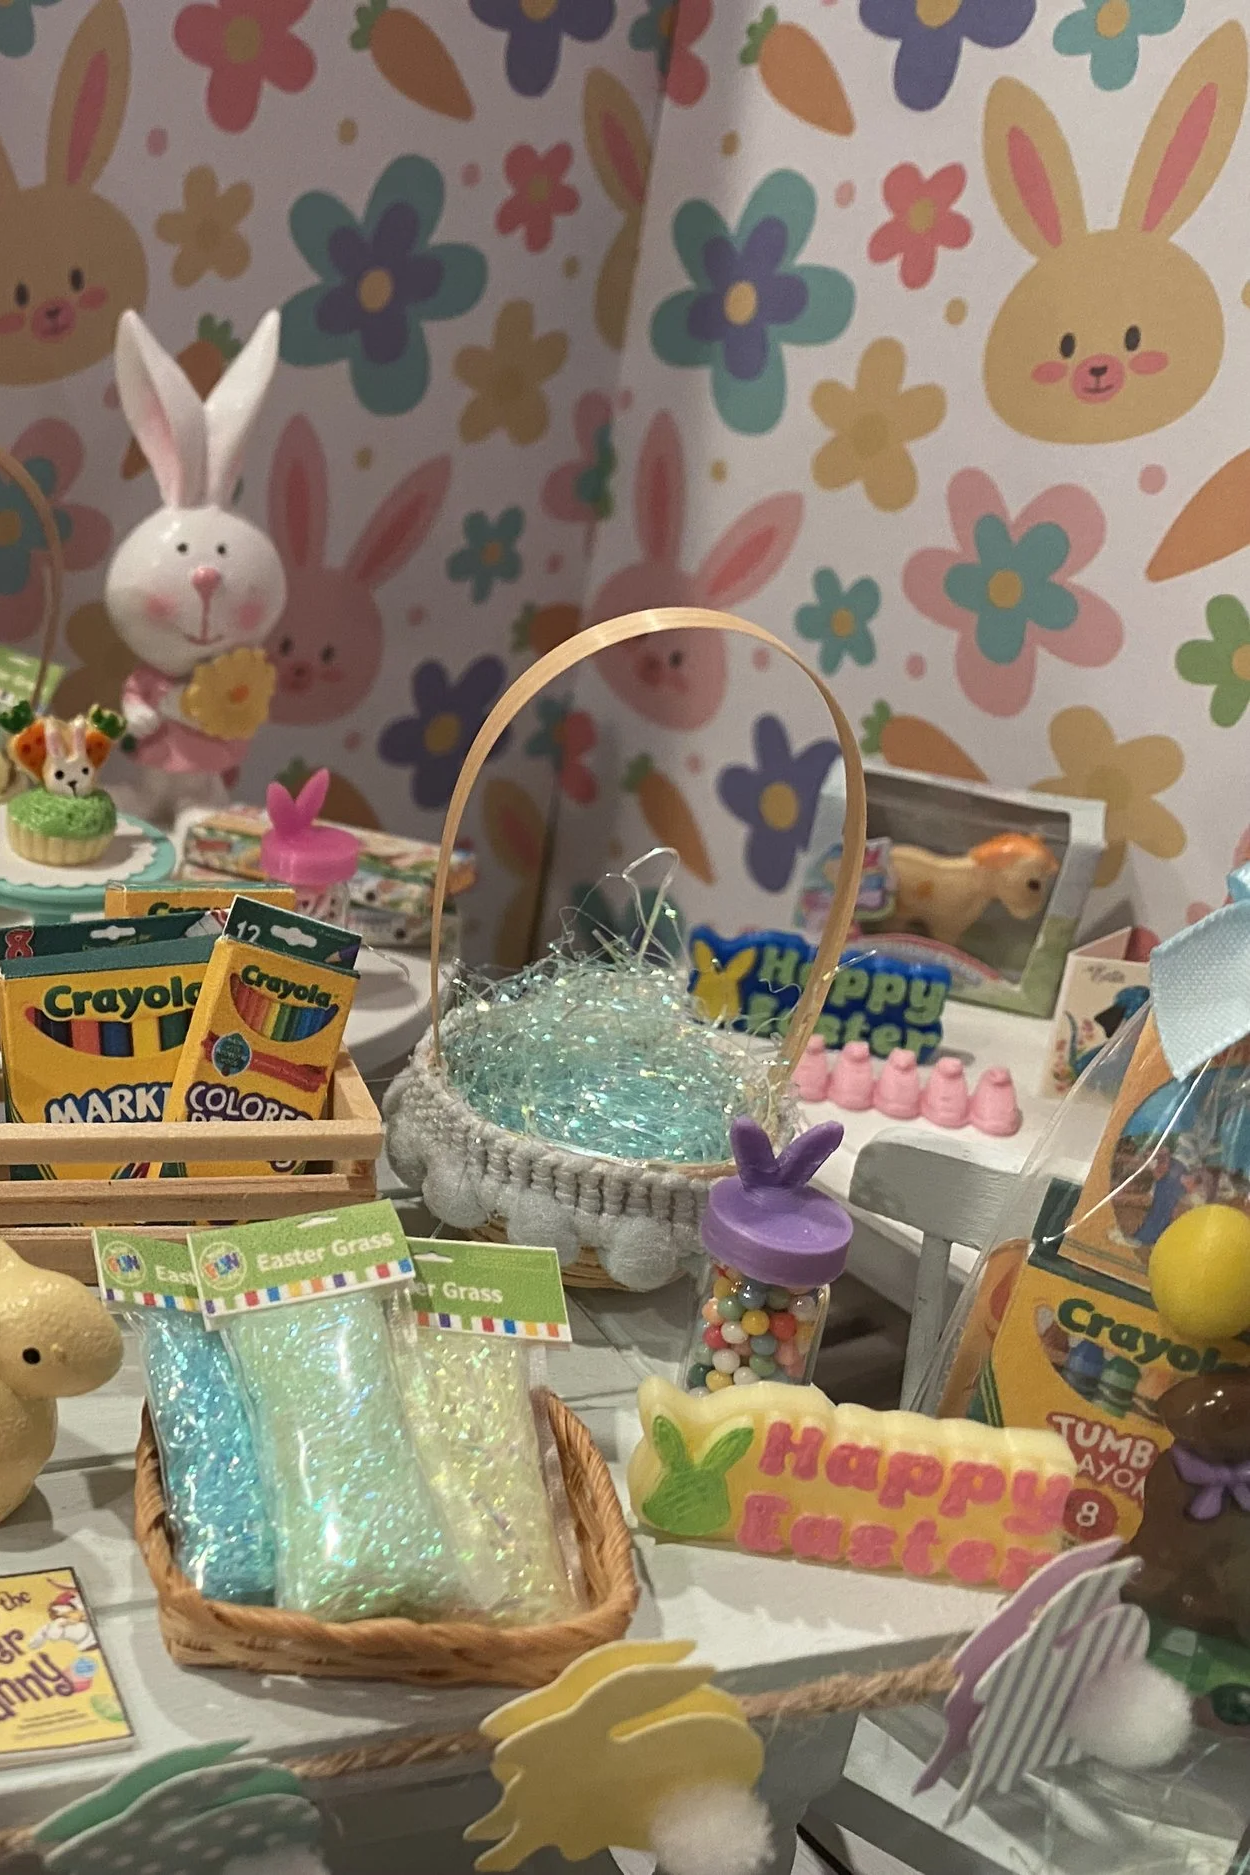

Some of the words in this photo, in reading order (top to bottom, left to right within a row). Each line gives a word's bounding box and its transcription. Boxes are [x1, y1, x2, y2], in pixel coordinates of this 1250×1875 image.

[4, 928, 34, 959] 8
[236, 920, 261, 943] 12
[241, 964, 332, 1008] Crayola
[49, 1083, 173, 1123] MARK
[189, 1084, 310, 1121] COLORE
[257, 1247, 326, 1272] Easter
[331, 1232, 395, 1257] Grass
[155, 1264, 198, 1285] East
[442, 1281, 504, 1304] Grass
[1057, 1298, 1232, 1372] Crayol
[758, 1419, 1075, 1537] Happy
[1075, 1501, 1100, 1528] 8
[737, 1492, 1052, 1591] Easter
